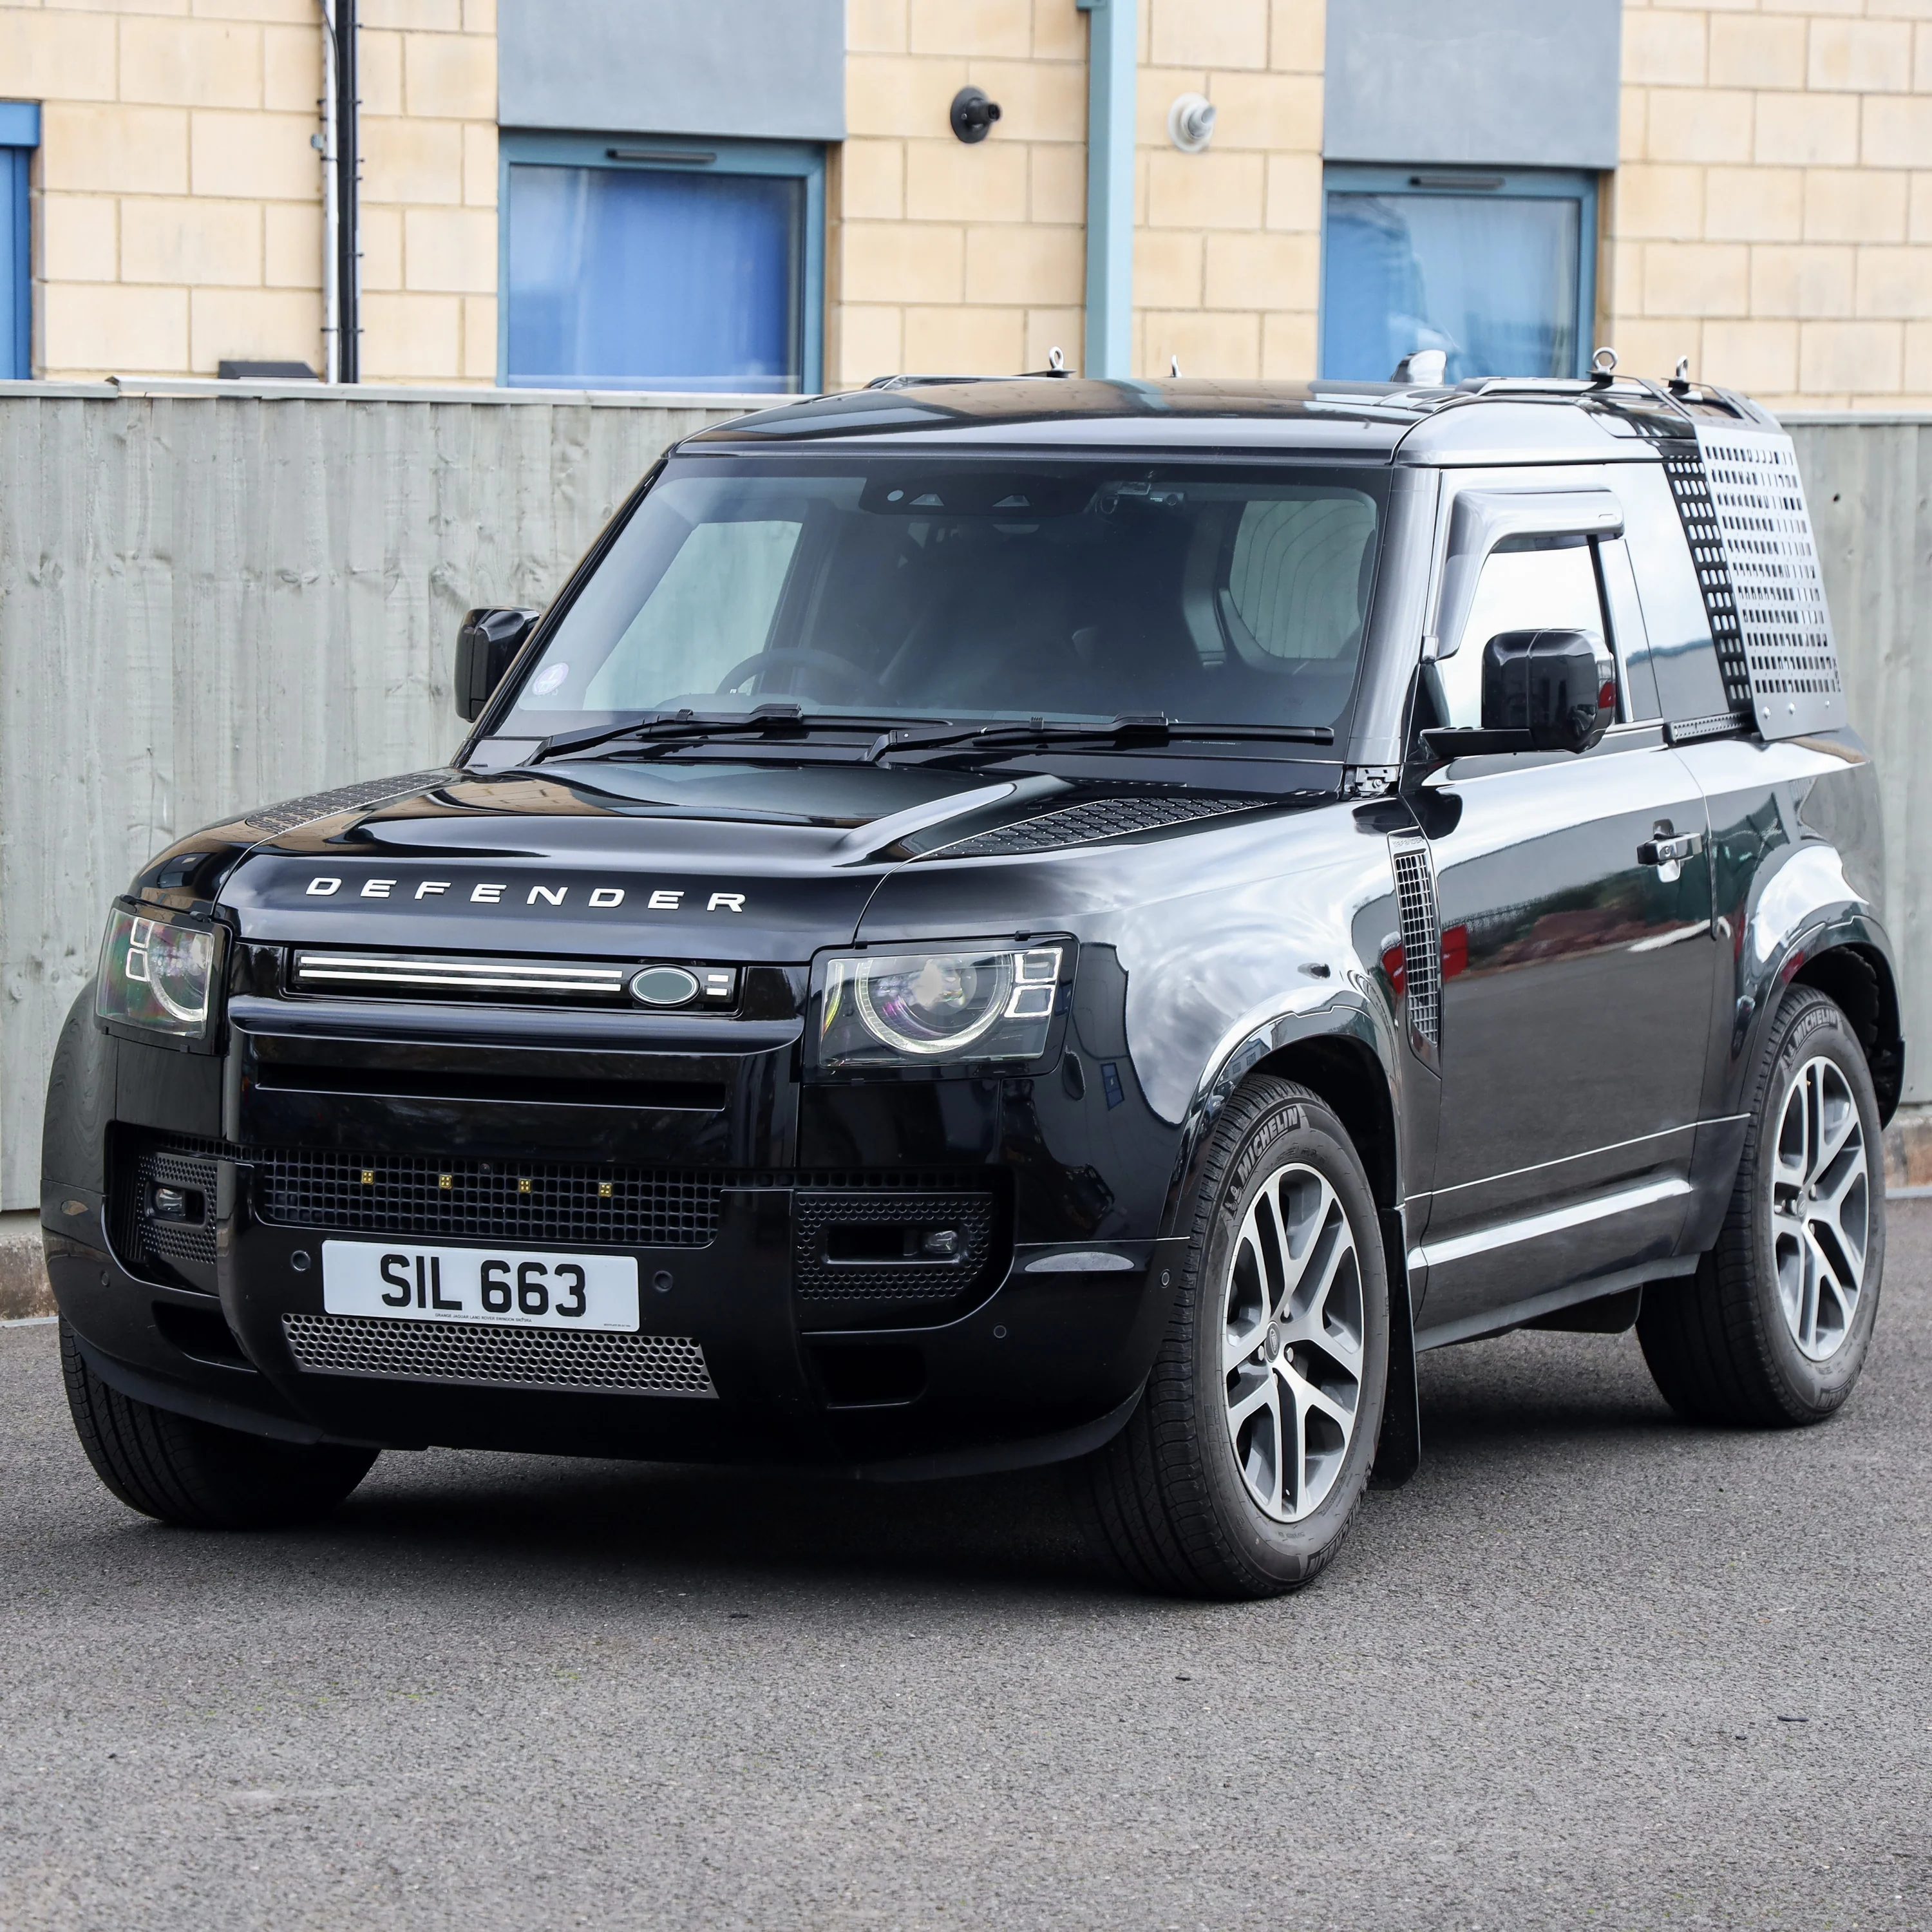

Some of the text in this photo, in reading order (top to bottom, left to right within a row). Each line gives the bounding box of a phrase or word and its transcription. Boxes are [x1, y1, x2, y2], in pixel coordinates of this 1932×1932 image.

[305, 877, 746, 913] DEFENDER
[1793, 1009, 1836, 1048] MICHELIN
[1237, 1106, 1299, 1185] MICHELIN
[381, 1254, 587, 1317] SIL 663
